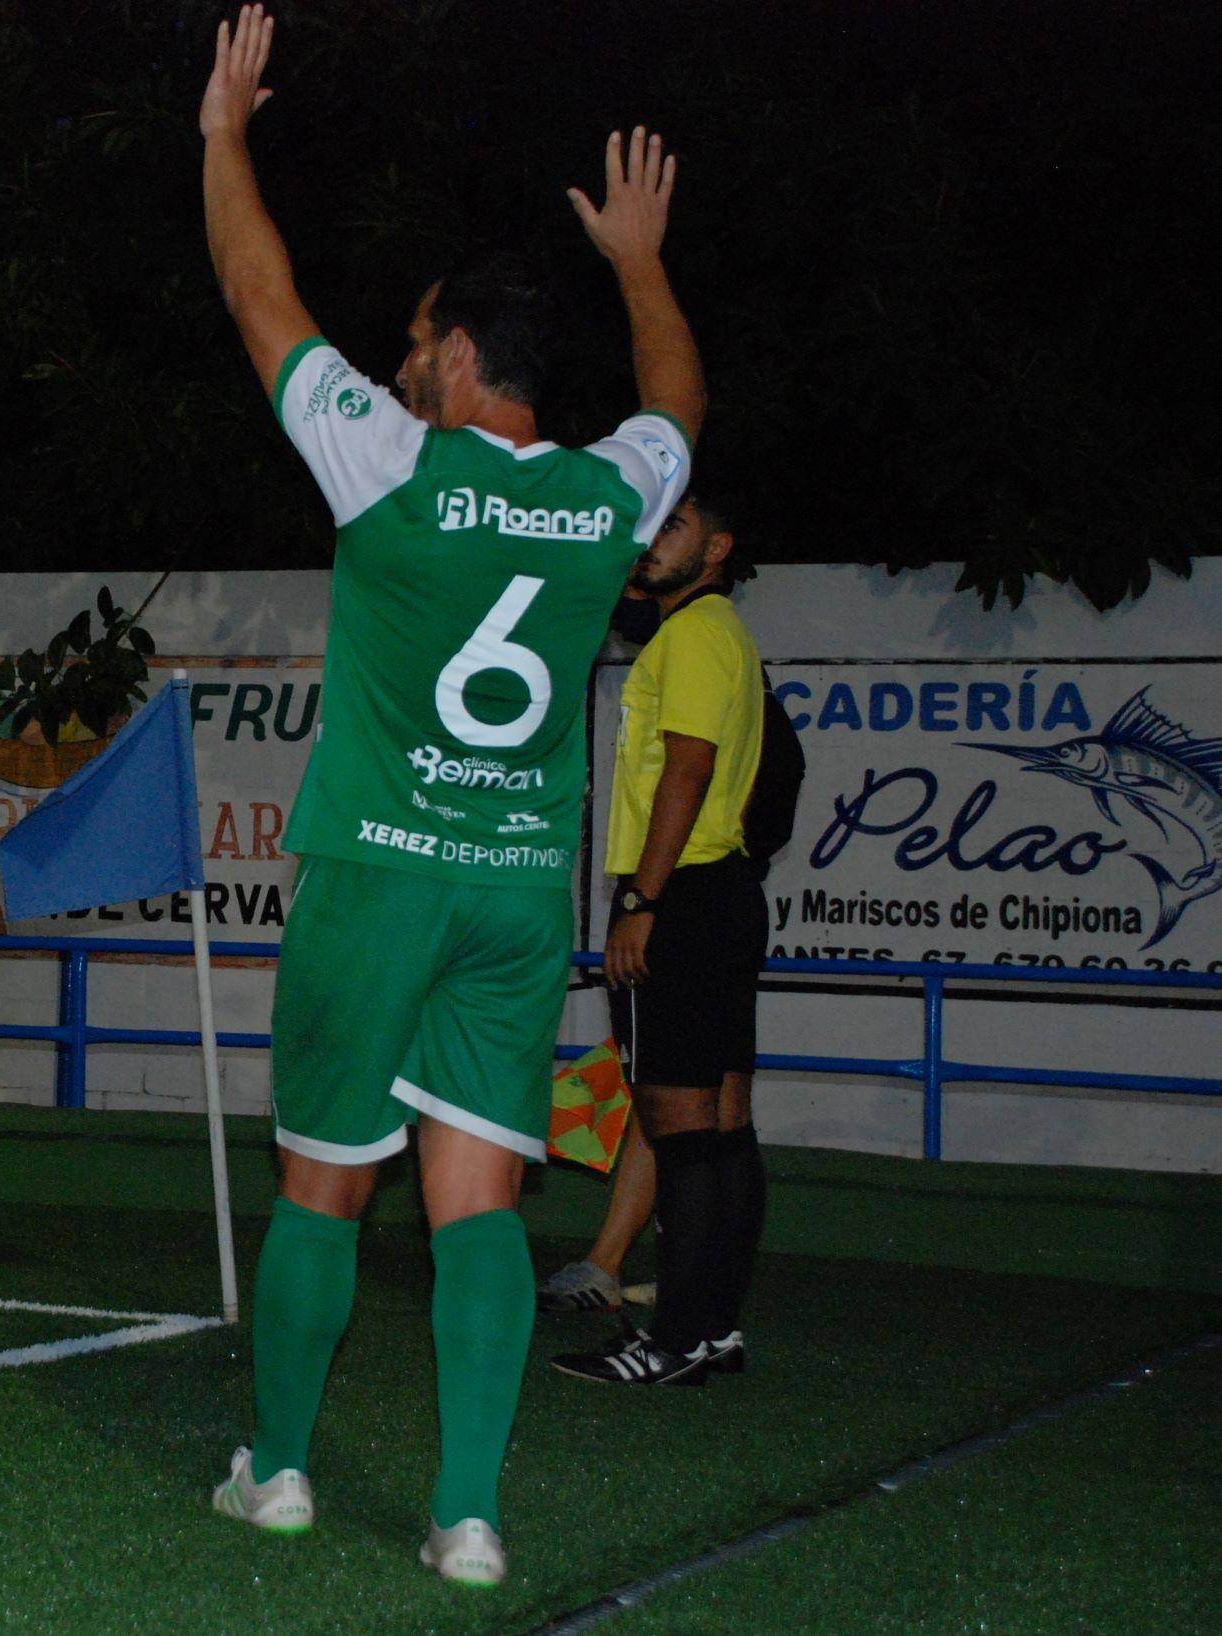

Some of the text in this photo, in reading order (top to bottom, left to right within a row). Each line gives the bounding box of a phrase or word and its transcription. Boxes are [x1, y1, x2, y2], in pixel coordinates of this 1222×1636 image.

[435, 574, 552, 748] 6
[357, 819, 439, 857] XEREZ
[441, 840, 559, 868] DEPORTIVO
[809, 767, 1129, 875] Pelao
[776, 889, 1142, 940] y Mariscos de Chipiona
